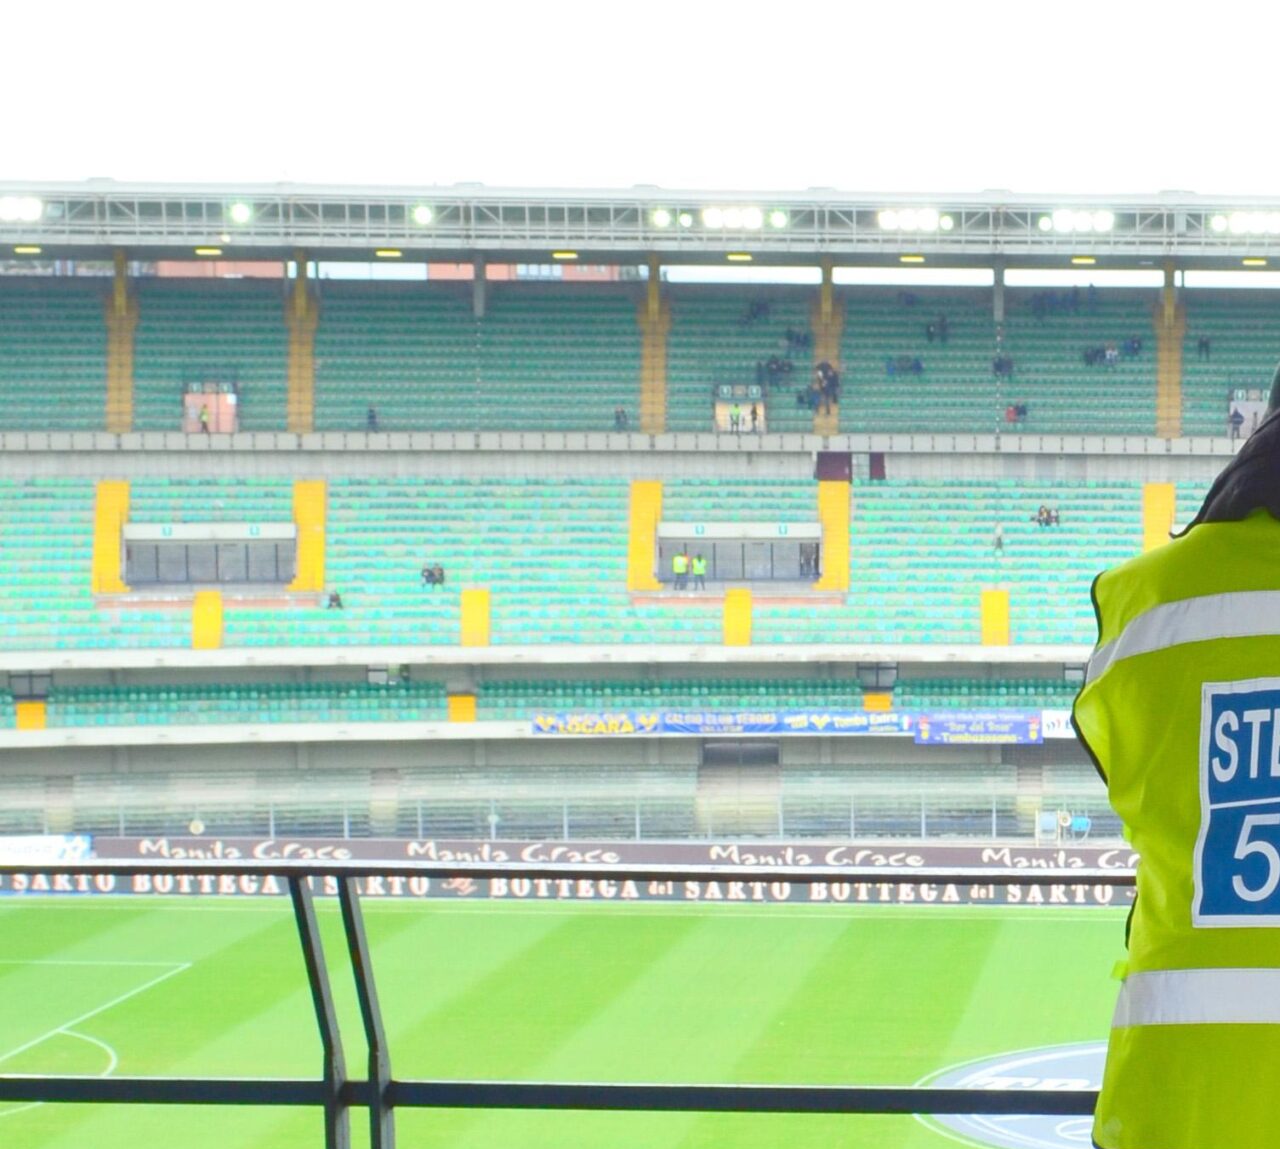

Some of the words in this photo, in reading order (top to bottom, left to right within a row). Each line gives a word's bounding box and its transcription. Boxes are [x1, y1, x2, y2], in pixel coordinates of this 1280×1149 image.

[139, 838, 242, 860] Manila
[253, 840, 353, 860] Grace
[407, 841, 508, 862] Manila
[521, 843, 621, 864] Grace
[709, 845, 812, 866] Manila
[825, 847, 925, 867] Grace
[982, 848, 1086, 868] Manila
[12, 874, 116, 892] SARTO
[133, 874, 281, 894] BOTTEGA
[490, 877, 639, 898] BOTTEGA
[648, 880, 673, 896] del
[685, 880, 790, 899] SARTO
[810, 882, 960, 902] BOTTEGA
[970, 884, 994, 899] del
[1007, 885, 1113, 904] SARTO
